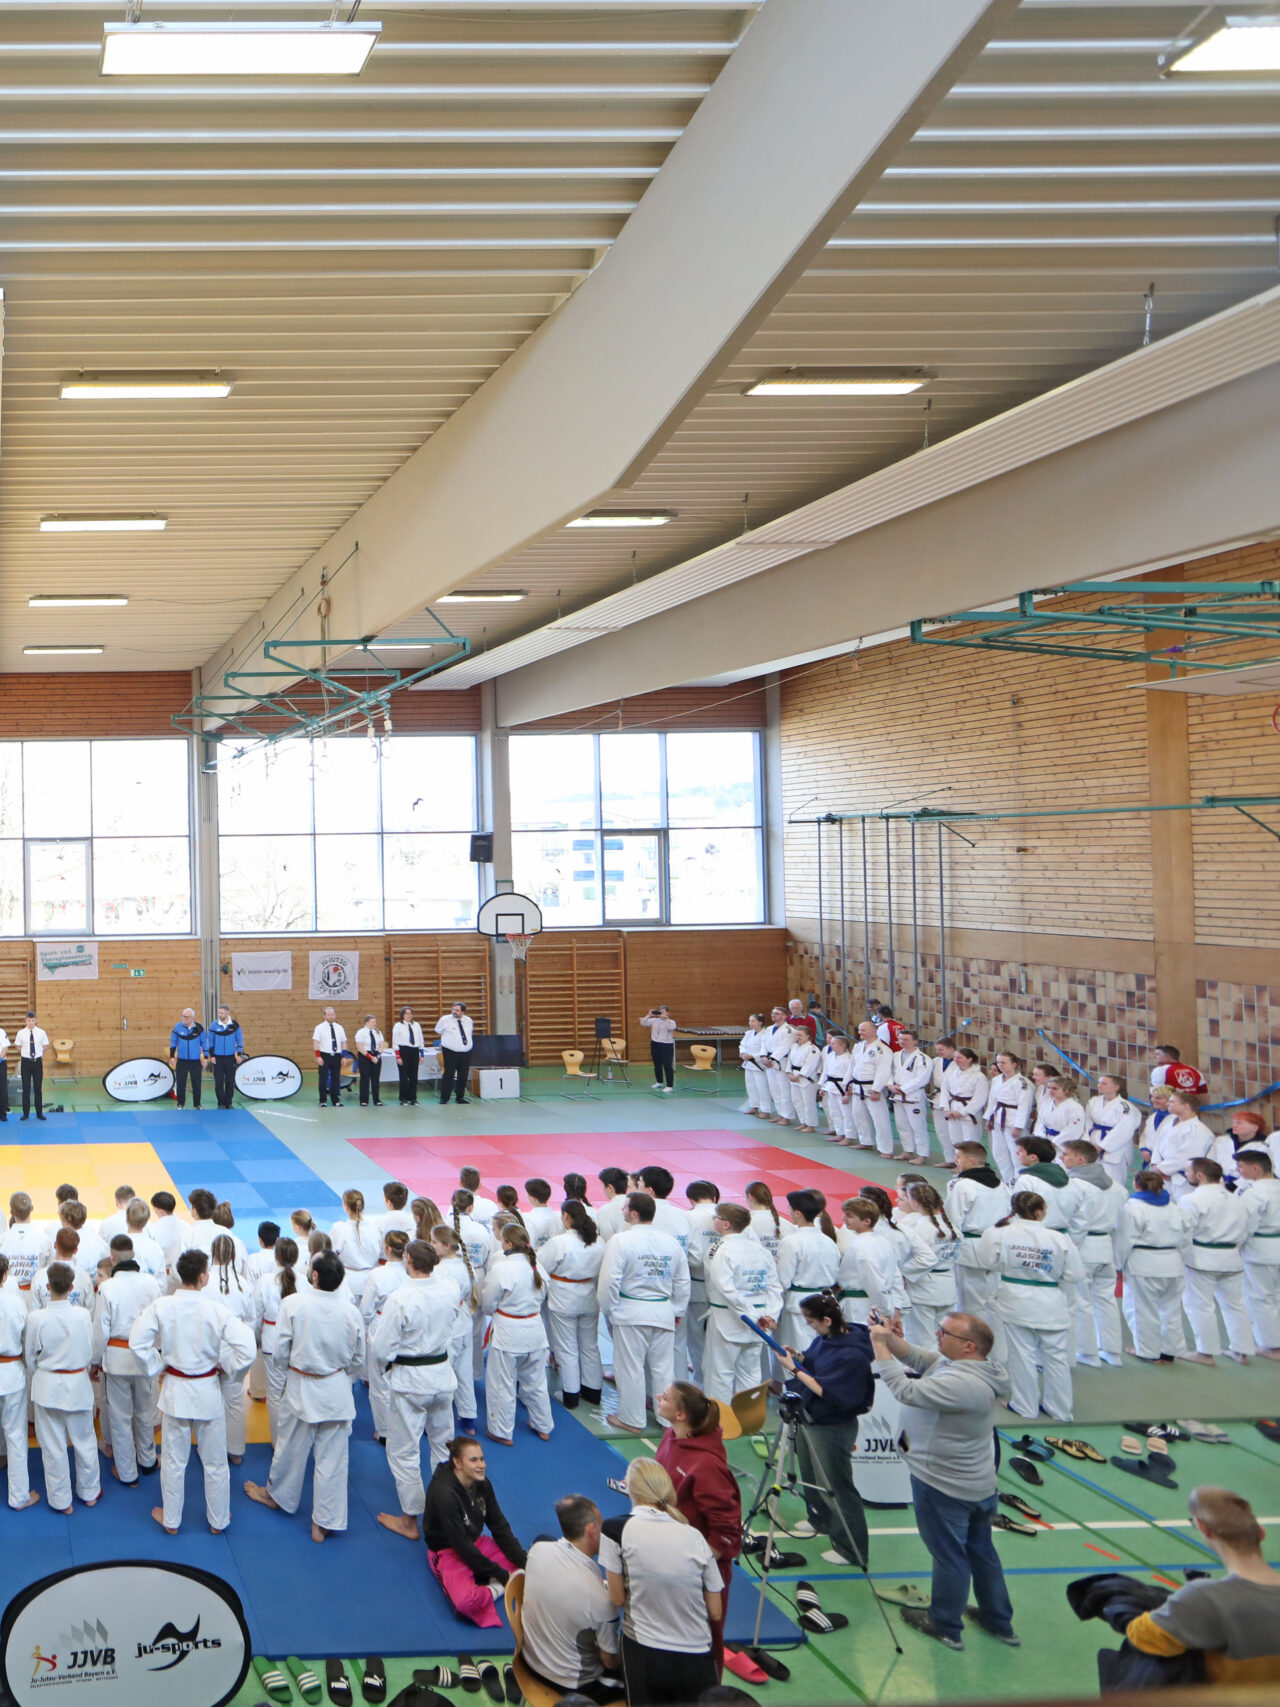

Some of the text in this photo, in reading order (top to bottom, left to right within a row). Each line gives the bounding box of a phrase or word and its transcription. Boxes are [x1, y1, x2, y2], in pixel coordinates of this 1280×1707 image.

[67, 1647, 116, 1670] JJVB
[134, 1638, 222, 1659] ju-sports
[30, 1672, 83, 1685] Ju-Jutsu-Verband
[83, 1670, 105, 1679] Bayern
